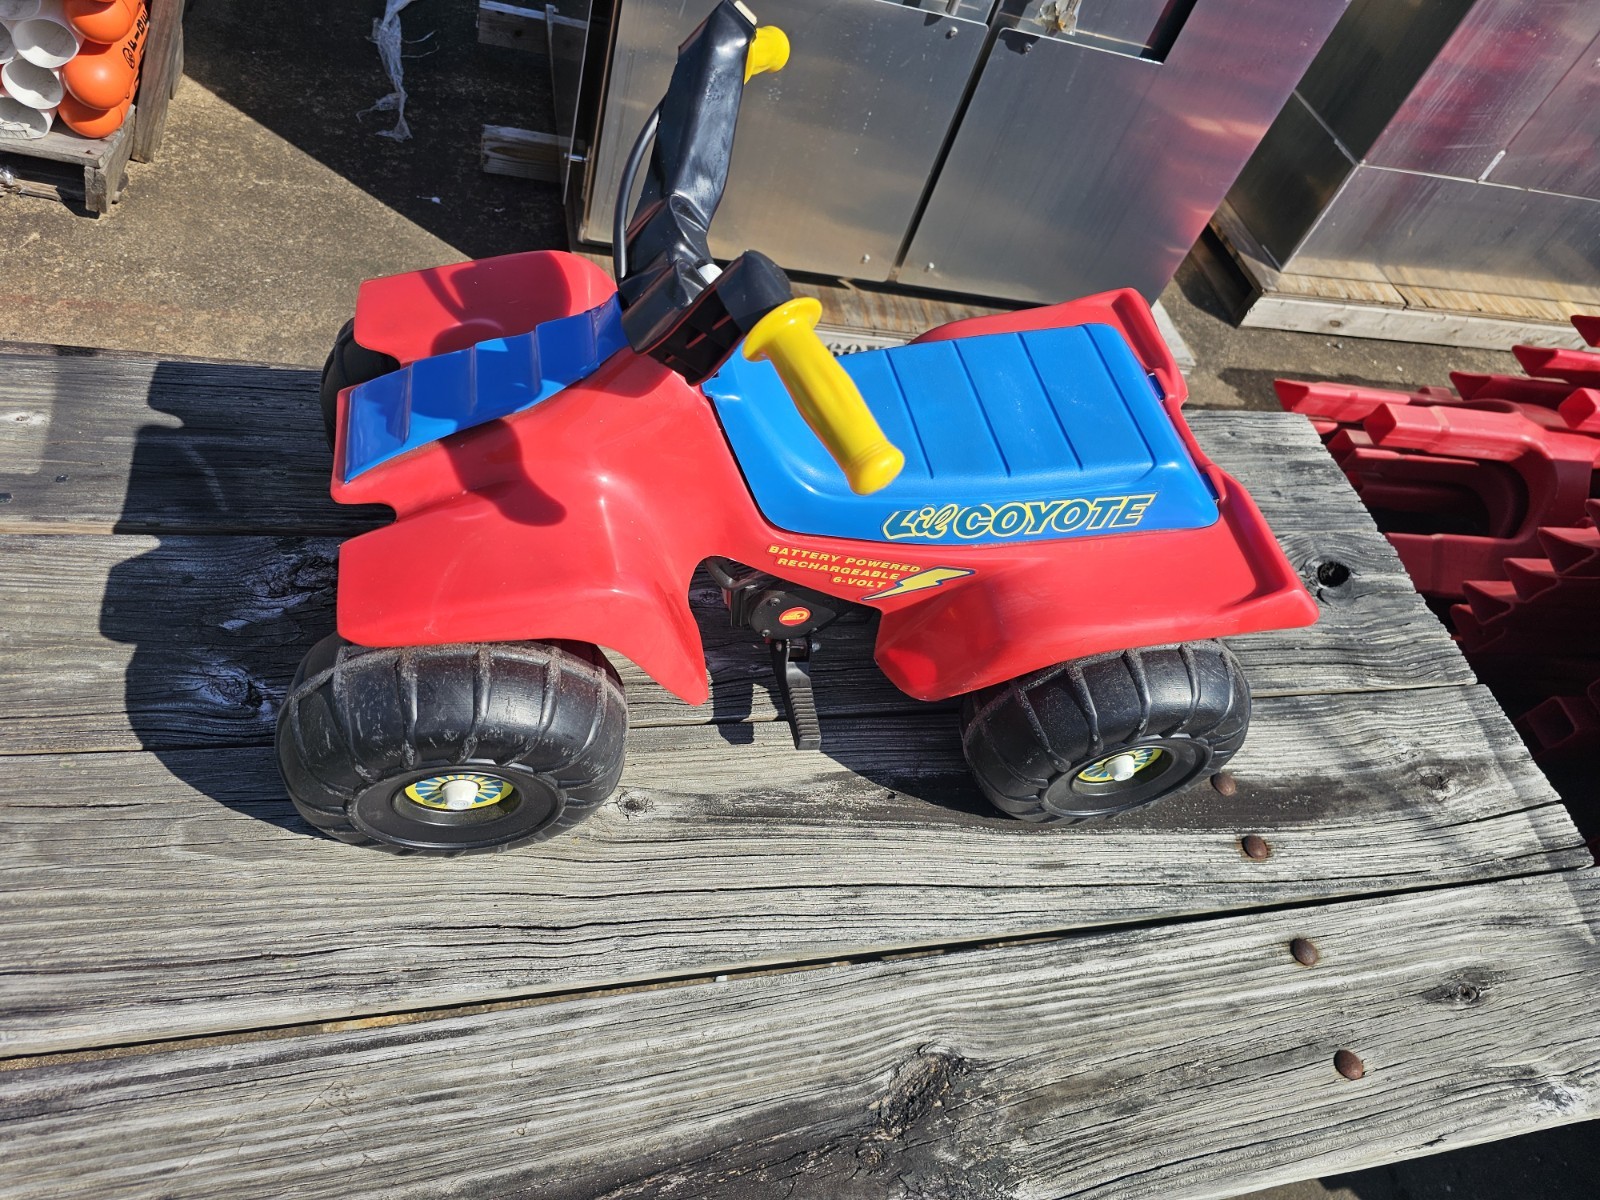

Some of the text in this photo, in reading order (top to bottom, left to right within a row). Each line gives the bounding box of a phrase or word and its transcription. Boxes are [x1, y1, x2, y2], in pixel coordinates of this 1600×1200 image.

[953, 492, 1157, 538] COYOTE
[768, 545, 921, 573] BATTERY POWERED
[777, 558, 900, 580] RECHARGEABLE
[833, 576, 886, 589] 6-VOLT
